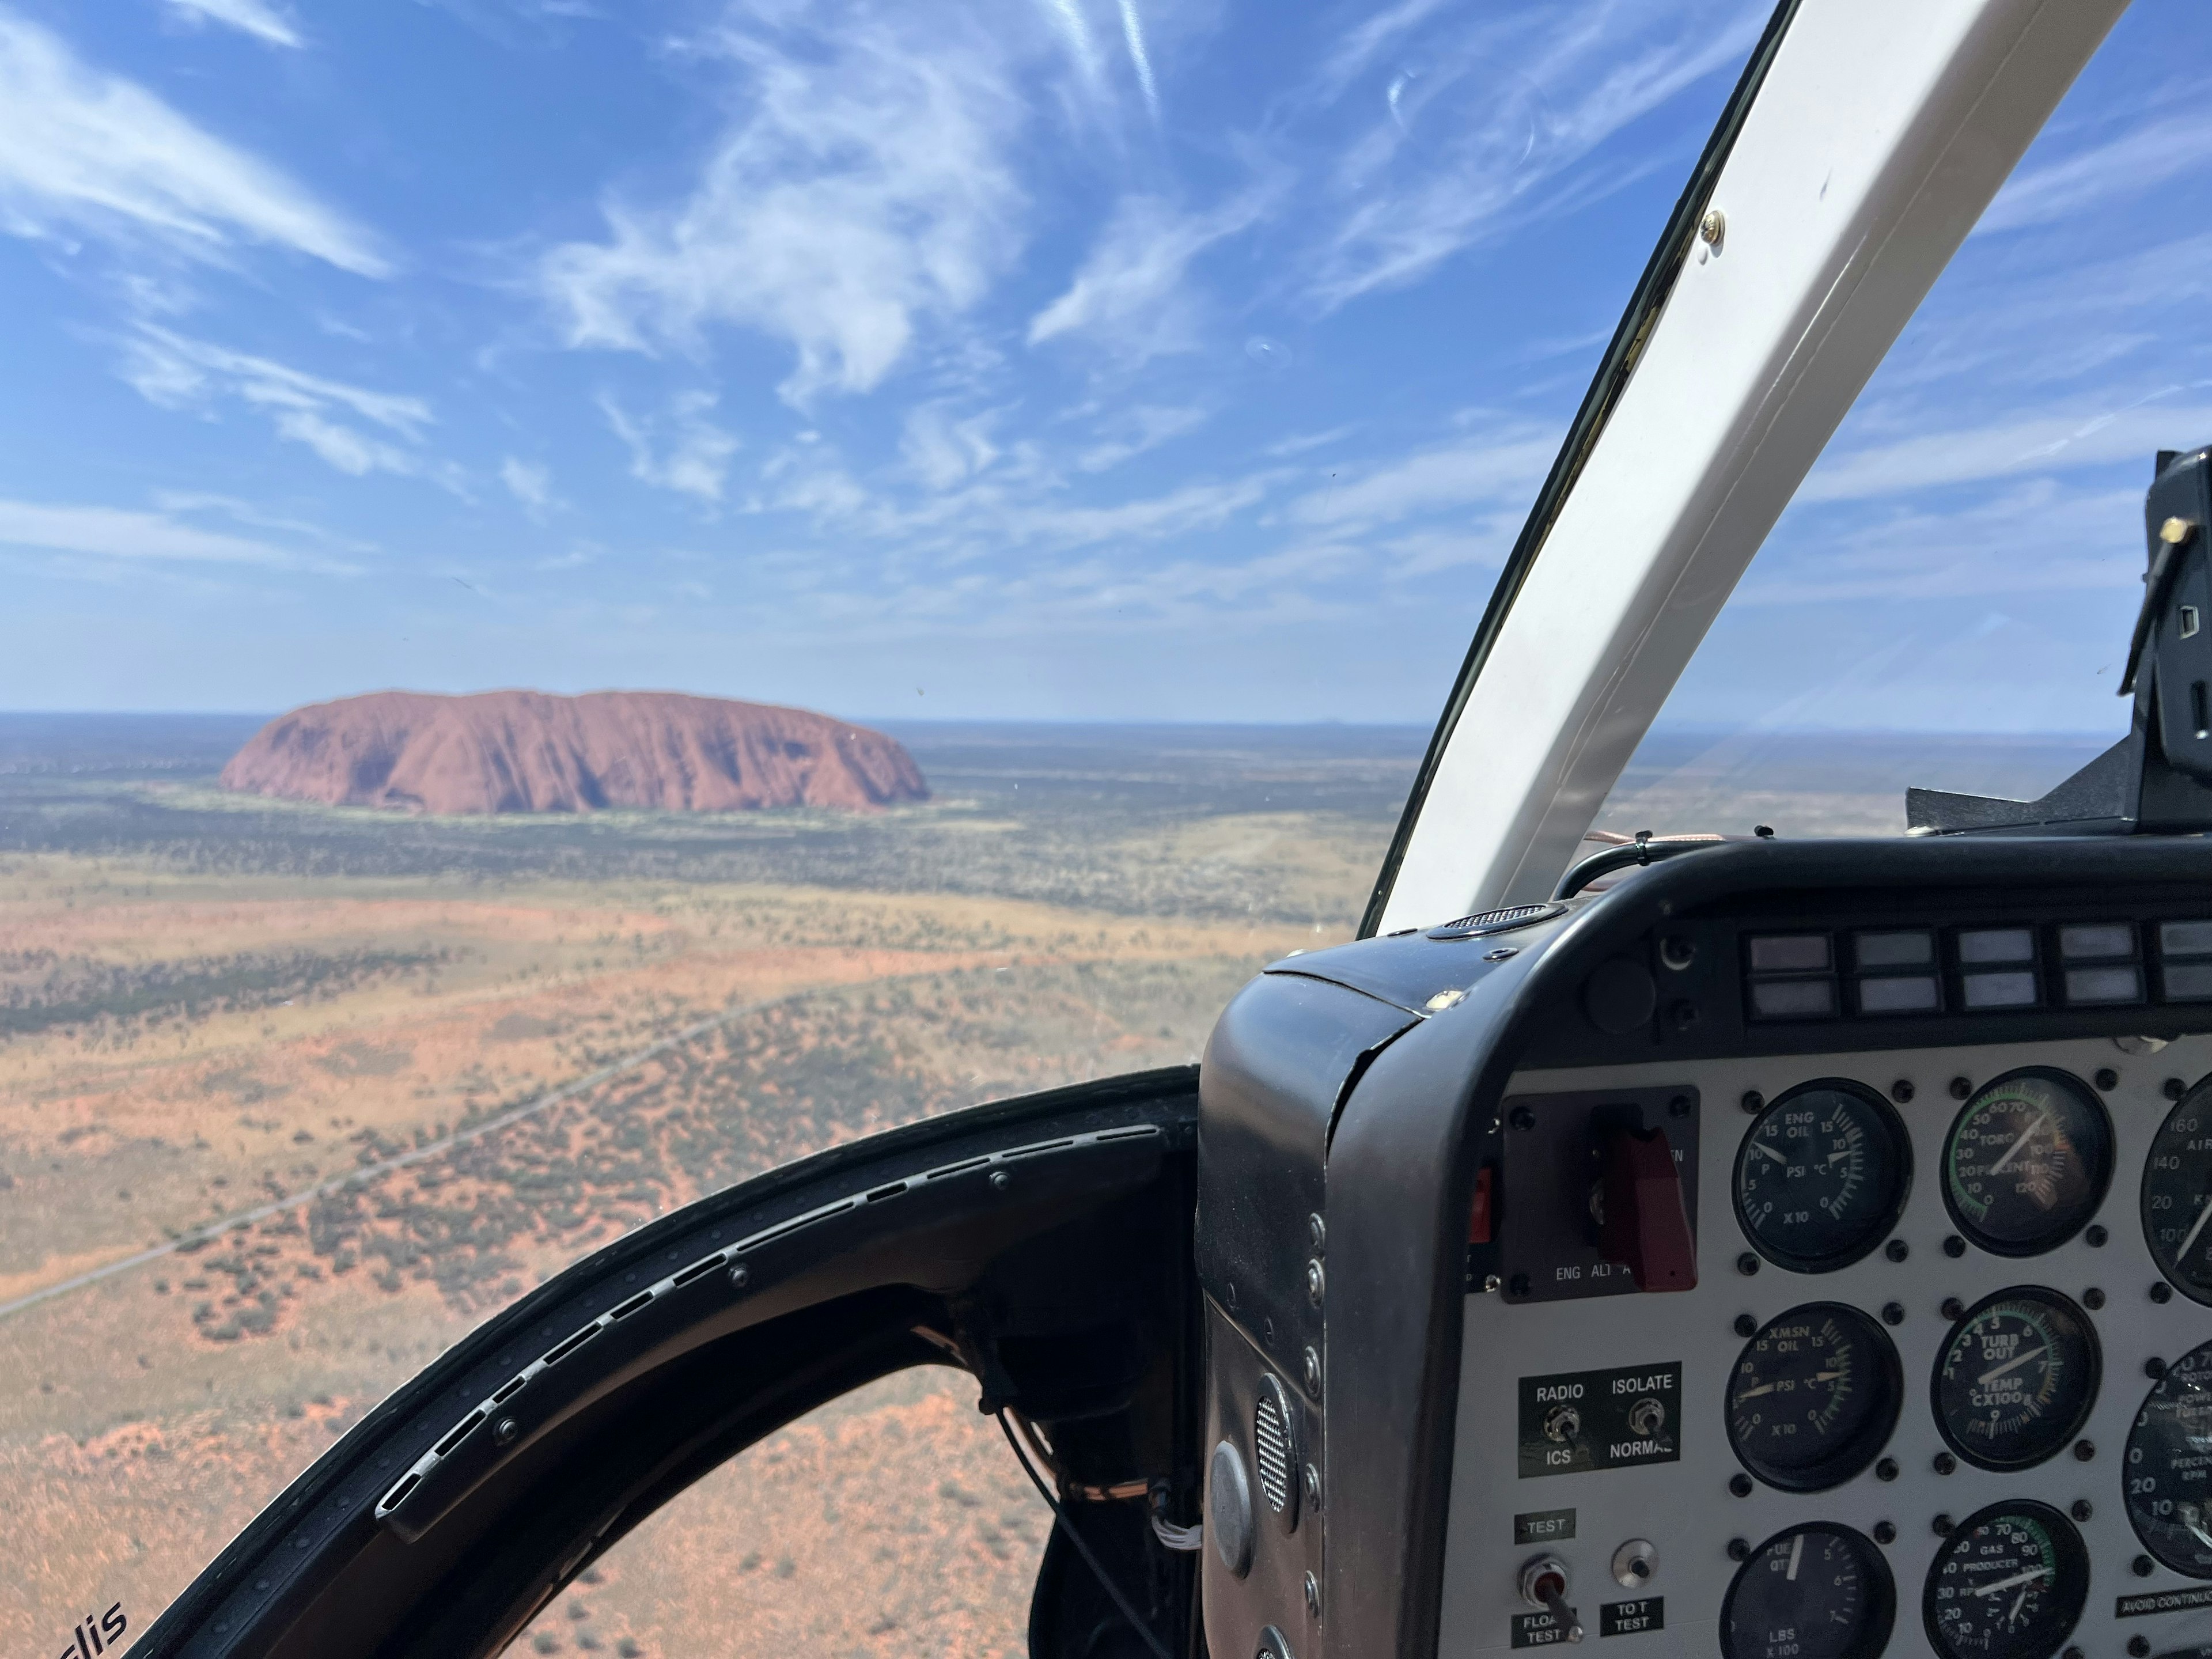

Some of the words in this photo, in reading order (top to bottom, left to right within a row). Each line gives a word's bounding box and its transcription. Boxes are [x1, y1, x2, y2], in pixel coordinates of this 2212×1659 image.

[1785, 1112, 1814, 1125] ENG
[1765, 1124, 1779, 1138] 15
[1786, 1126, 1809, 1139] OIL
[1820, 1121, 1834, 1134] 15
[1832, 1138, 1846, 1150] 10
[1750, 1148, 1763, 1161] 10
[1786, 1166, 1805, 1179] PSI
[1556, 1266, 1581, 1281] ENG
[1769, 1326, 1810, 1339] XMSN
[2022, 1324, 2033, 1337] 6
[1756, 1339, 1770, 1352] 15
[1777, 1340, 1798, 1353] OIL
[1812, 1336, 1824, 1347] 15
[1961, 1334, 1971, 1347] 3
[1980, 1334, 2020, 1348] TURB
[1952, 1349, 1963, 1363] 2
[1983, 1347, 2016, 1360] OUT
[1740, 1362, 1754, 1374] 10
[1612, 1374, 1673, 1395] ISOLATE
[1776, 1380, 1796, 1392] PSI
[1984, 1378, 2023, 1392] TEMP
[1536, 1384, 1584, 1402] RADIO
[1610, 1440, 1673, 1459] NORMA
[1546, 1449, 1571, 1465] ICS
[2130, 1476, 2156, 1494] 20
[2152, 1499, 2173, 1516] 10
[1527, 1518, 1567, 1533] TEST
[2011, 1532, 2028, 1544] 80
[1824, 1548, 1831, 1561] 5
[1979, 1544, 2004, 1555] GAS
[2021, 1544, 2039, 1556] 90
[1963, 1559, 2018, 1572] PRODUCER
[1937, 1586, 1955, 1599] 30
[2122, 1597, 2156, 1612] AVOID
[1944, 1607, 1962, 1620] 20
[1615, 1616, 1650, 1631] TEST
[1527, 1629, 1562, 1644] TEST
[1769, 1628, 1796, 1643] LBS
[1778, 1643, 1798, 1656] 100
